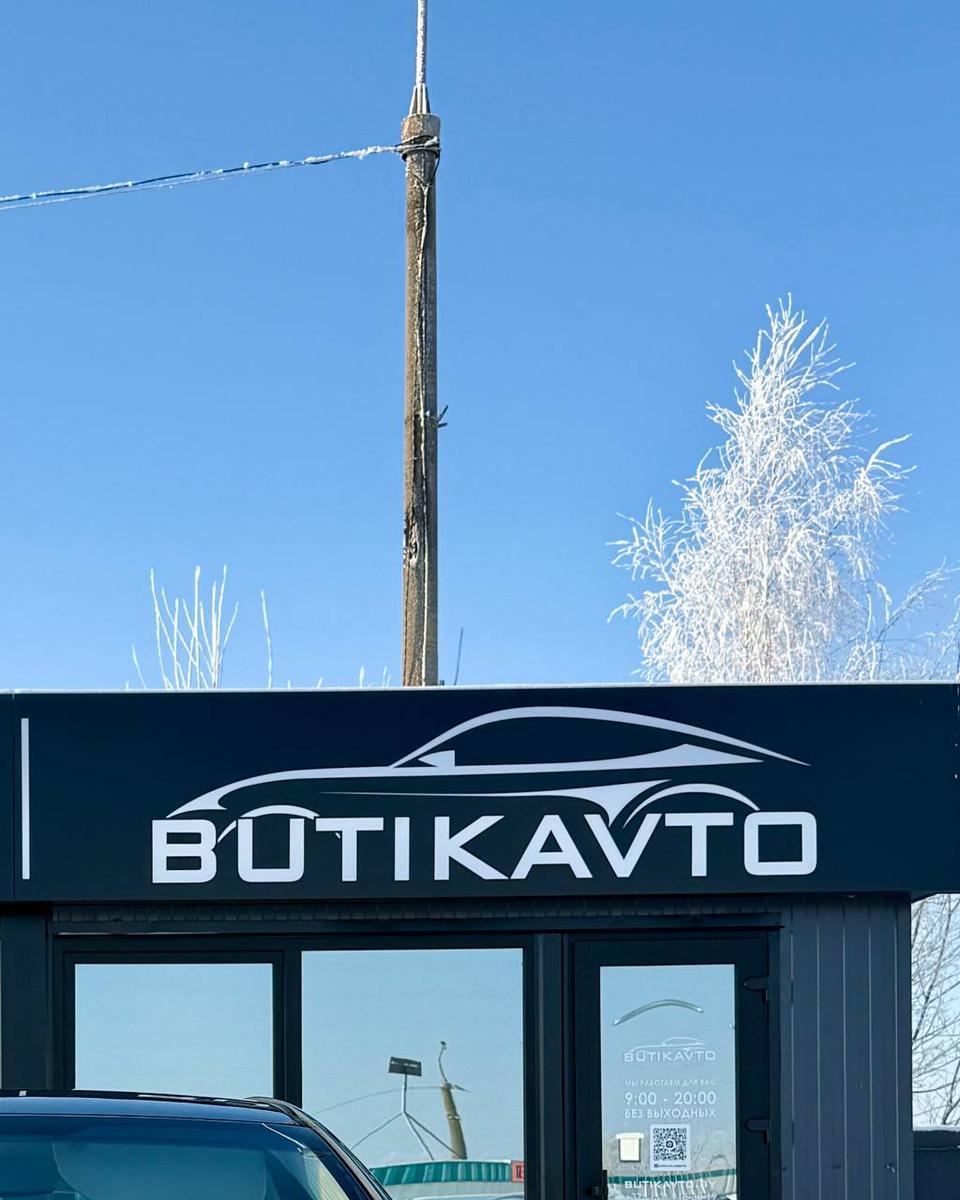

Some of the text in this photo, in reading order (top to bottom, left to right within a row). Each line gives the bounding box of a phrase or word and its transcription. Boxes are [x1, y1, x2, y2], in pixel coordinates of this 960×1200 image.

[151, 810, 819, 885] BUTIKAVTO
[624, 1050, 716, 1062] BUTIKAVTO
[624, 1091, 657, 1105] 9:00
[674, 1091, 716, 1105] 20:00
[624, 1107, 716, 1118] БЕЗ ВЫХОДНЫХ
